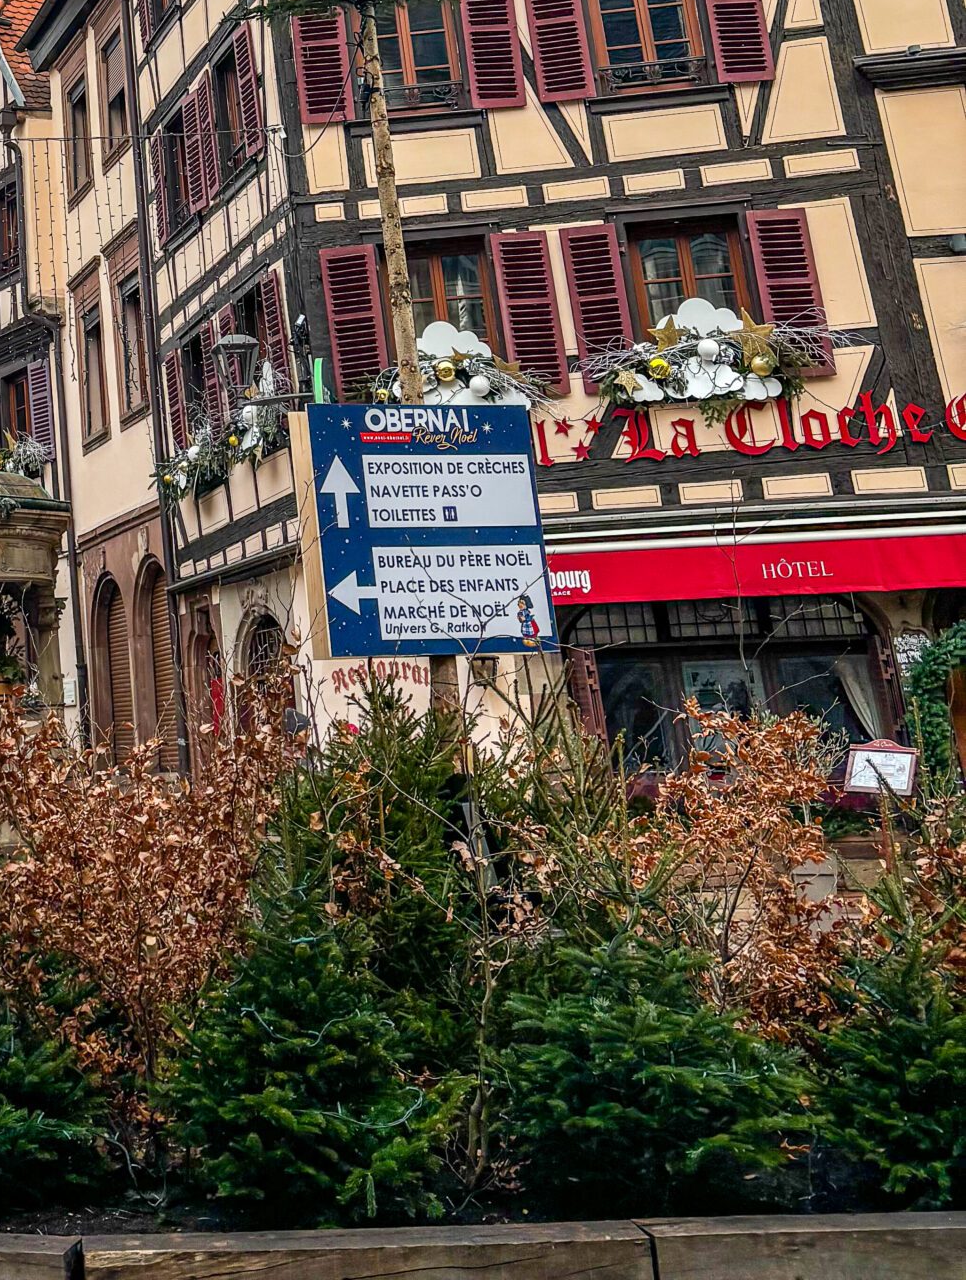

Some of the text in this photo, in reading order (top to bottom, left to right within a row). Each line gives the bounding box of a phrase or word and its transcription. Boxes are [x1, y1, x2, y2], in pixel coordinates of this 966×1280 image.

[364, 408, 470, 432] OBERNAI
[612, 406, 702, 463] La
[724, 389, 934, 456] Cloche
[450, 426, 478, 444] Noël
[367, 458, 525, 475] EXPOSITION DE CRÈCHES
[370, 484, 482, 498] NAVETTE PASS'O
[371, 508, 436, 521] TOILETTES
[378, 550, 532, 568] BUREAU DU PÈRE NOËL
[761, 558, 834, 579] HÔTEL
[380, 578, 519, 593] PLACE DES ENFANTS
[383, 601, 510, 619] MARCHÉ DE NOËL
[385, 622, 427, 634] Univers
